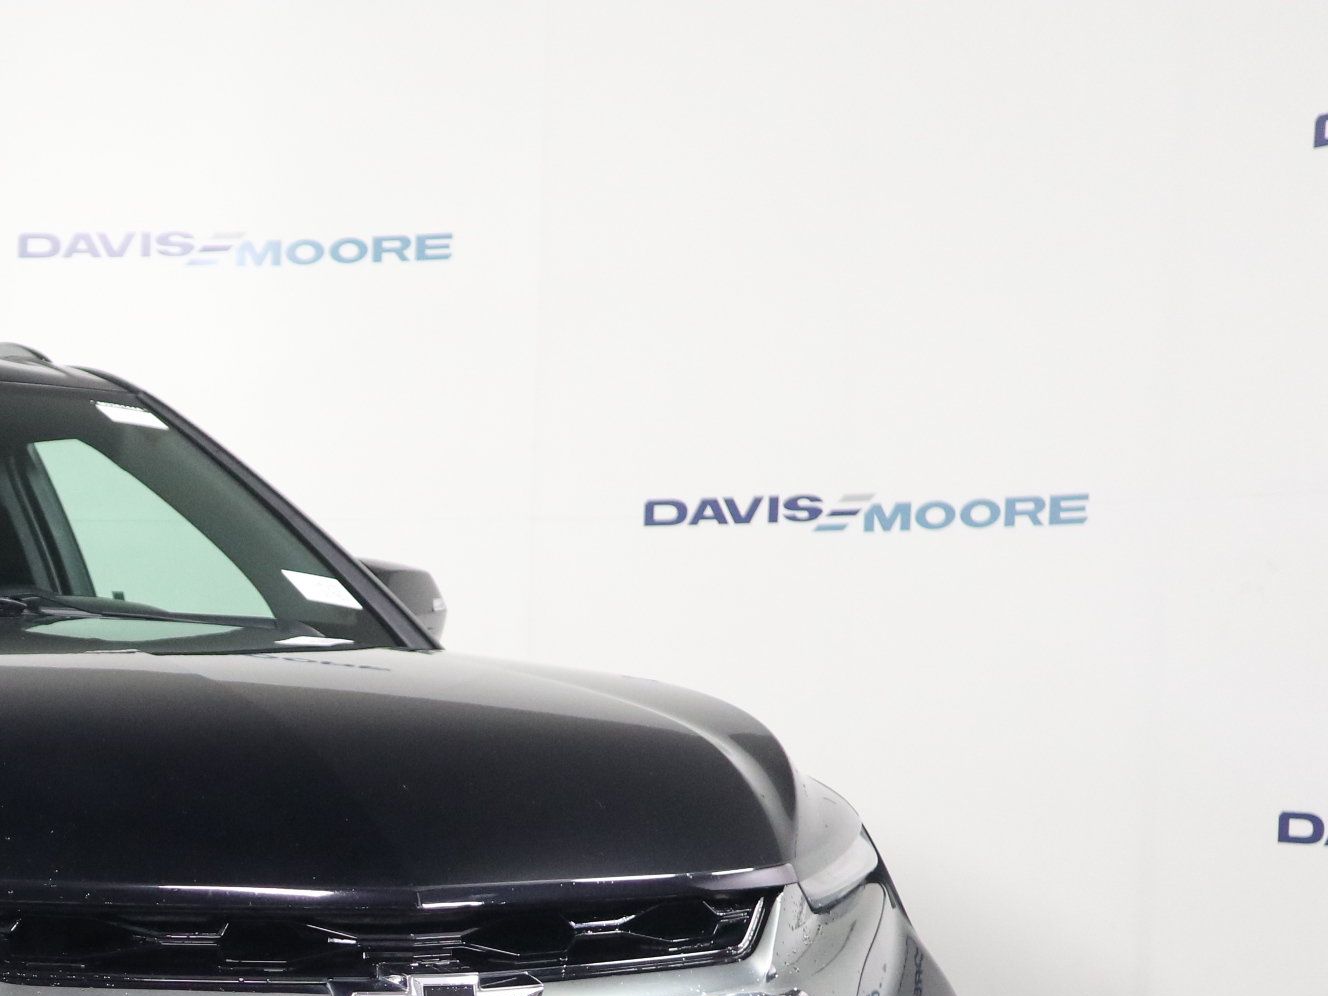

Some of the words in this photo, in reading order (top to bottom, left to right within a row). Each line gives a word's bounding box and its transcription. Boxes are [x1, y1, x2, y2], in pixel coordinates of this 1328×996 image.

[17, 231, 194, 259] DAVIS
[234, 232, 453, 266] MOORE
[643, 494, 823, 527] DAVIS
[863, 493, 1090, 532] MOORE
